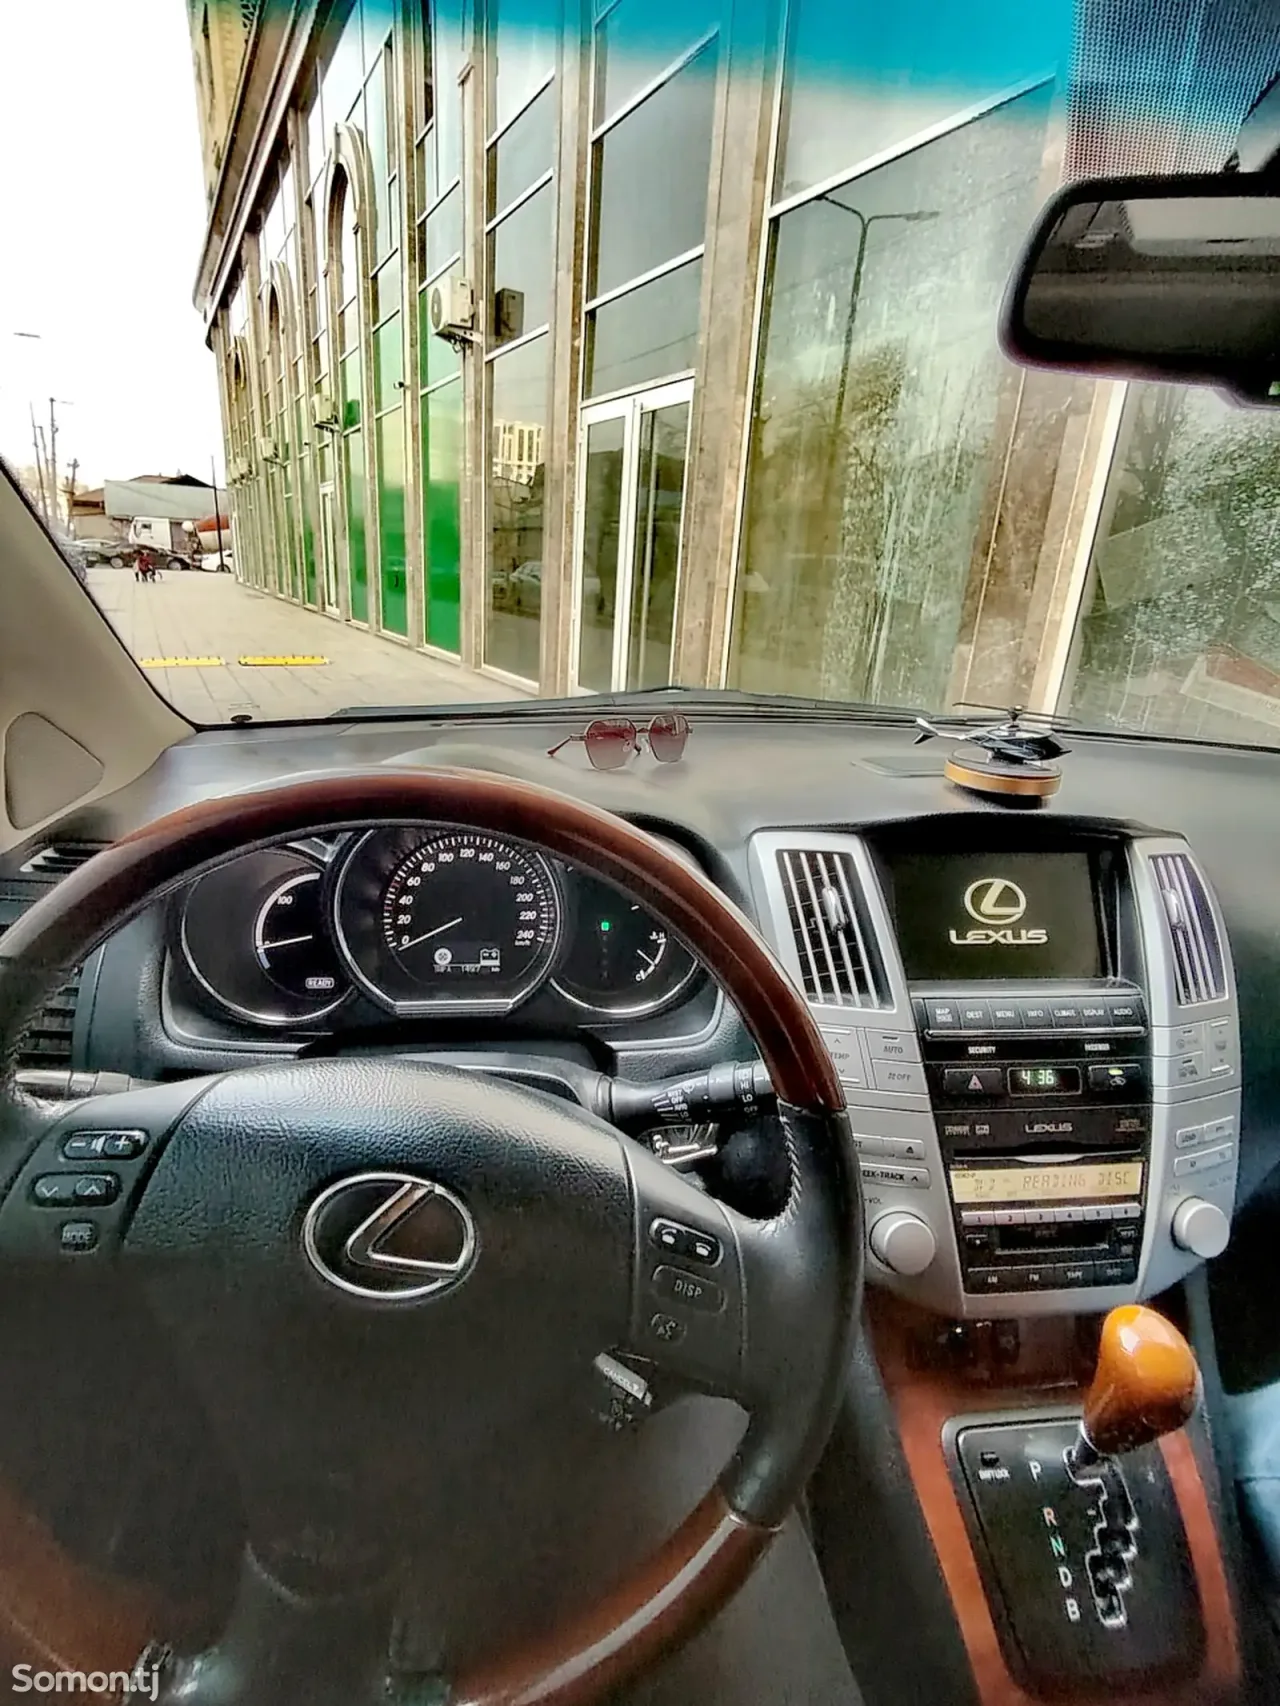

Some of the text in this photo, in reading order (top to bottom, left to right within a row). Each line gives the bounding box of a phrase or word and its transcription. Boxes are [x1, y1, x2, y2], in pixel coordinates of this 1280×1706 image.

[438, 853, 454, 862] 100
[460, 849, 475, 858] 120
[479, 853, 494, 862] 140
[421, 863, 435, 872] 80
[495, 862, 511, 870] 160
[407, 877, 421, 886] 60
[510, 876, 525, 885] 180
[277, 896, 293, 905] 100
[399, 896, 413, 905] 40
[516, 893, 533, 902] 200
[397, 915, 411, 924] 20
[519, 911, 536, 920] 220
[516, 930, 534, 939] 240
[949, 929, 1048, 944] LEXUS
[401, 935, 410, 945] 0
[883, 1046, 904, 1054] AUTO
[897, 1073, 911, 1081] OFF
[1024, 1122, 1073, 1133] LEXUS
[674, 1279, 703, 1298] DISP
[603, 1365, 633, 1389] CANCEL
[1028, 1460, 1042, 1482] P
[1042, 1506, 1058, 1528] R
[1049, 1534, 1066, 1559] N
[1058, 1566, 1073, 1588] D
[1065, 1598, 1081, 1623] B
